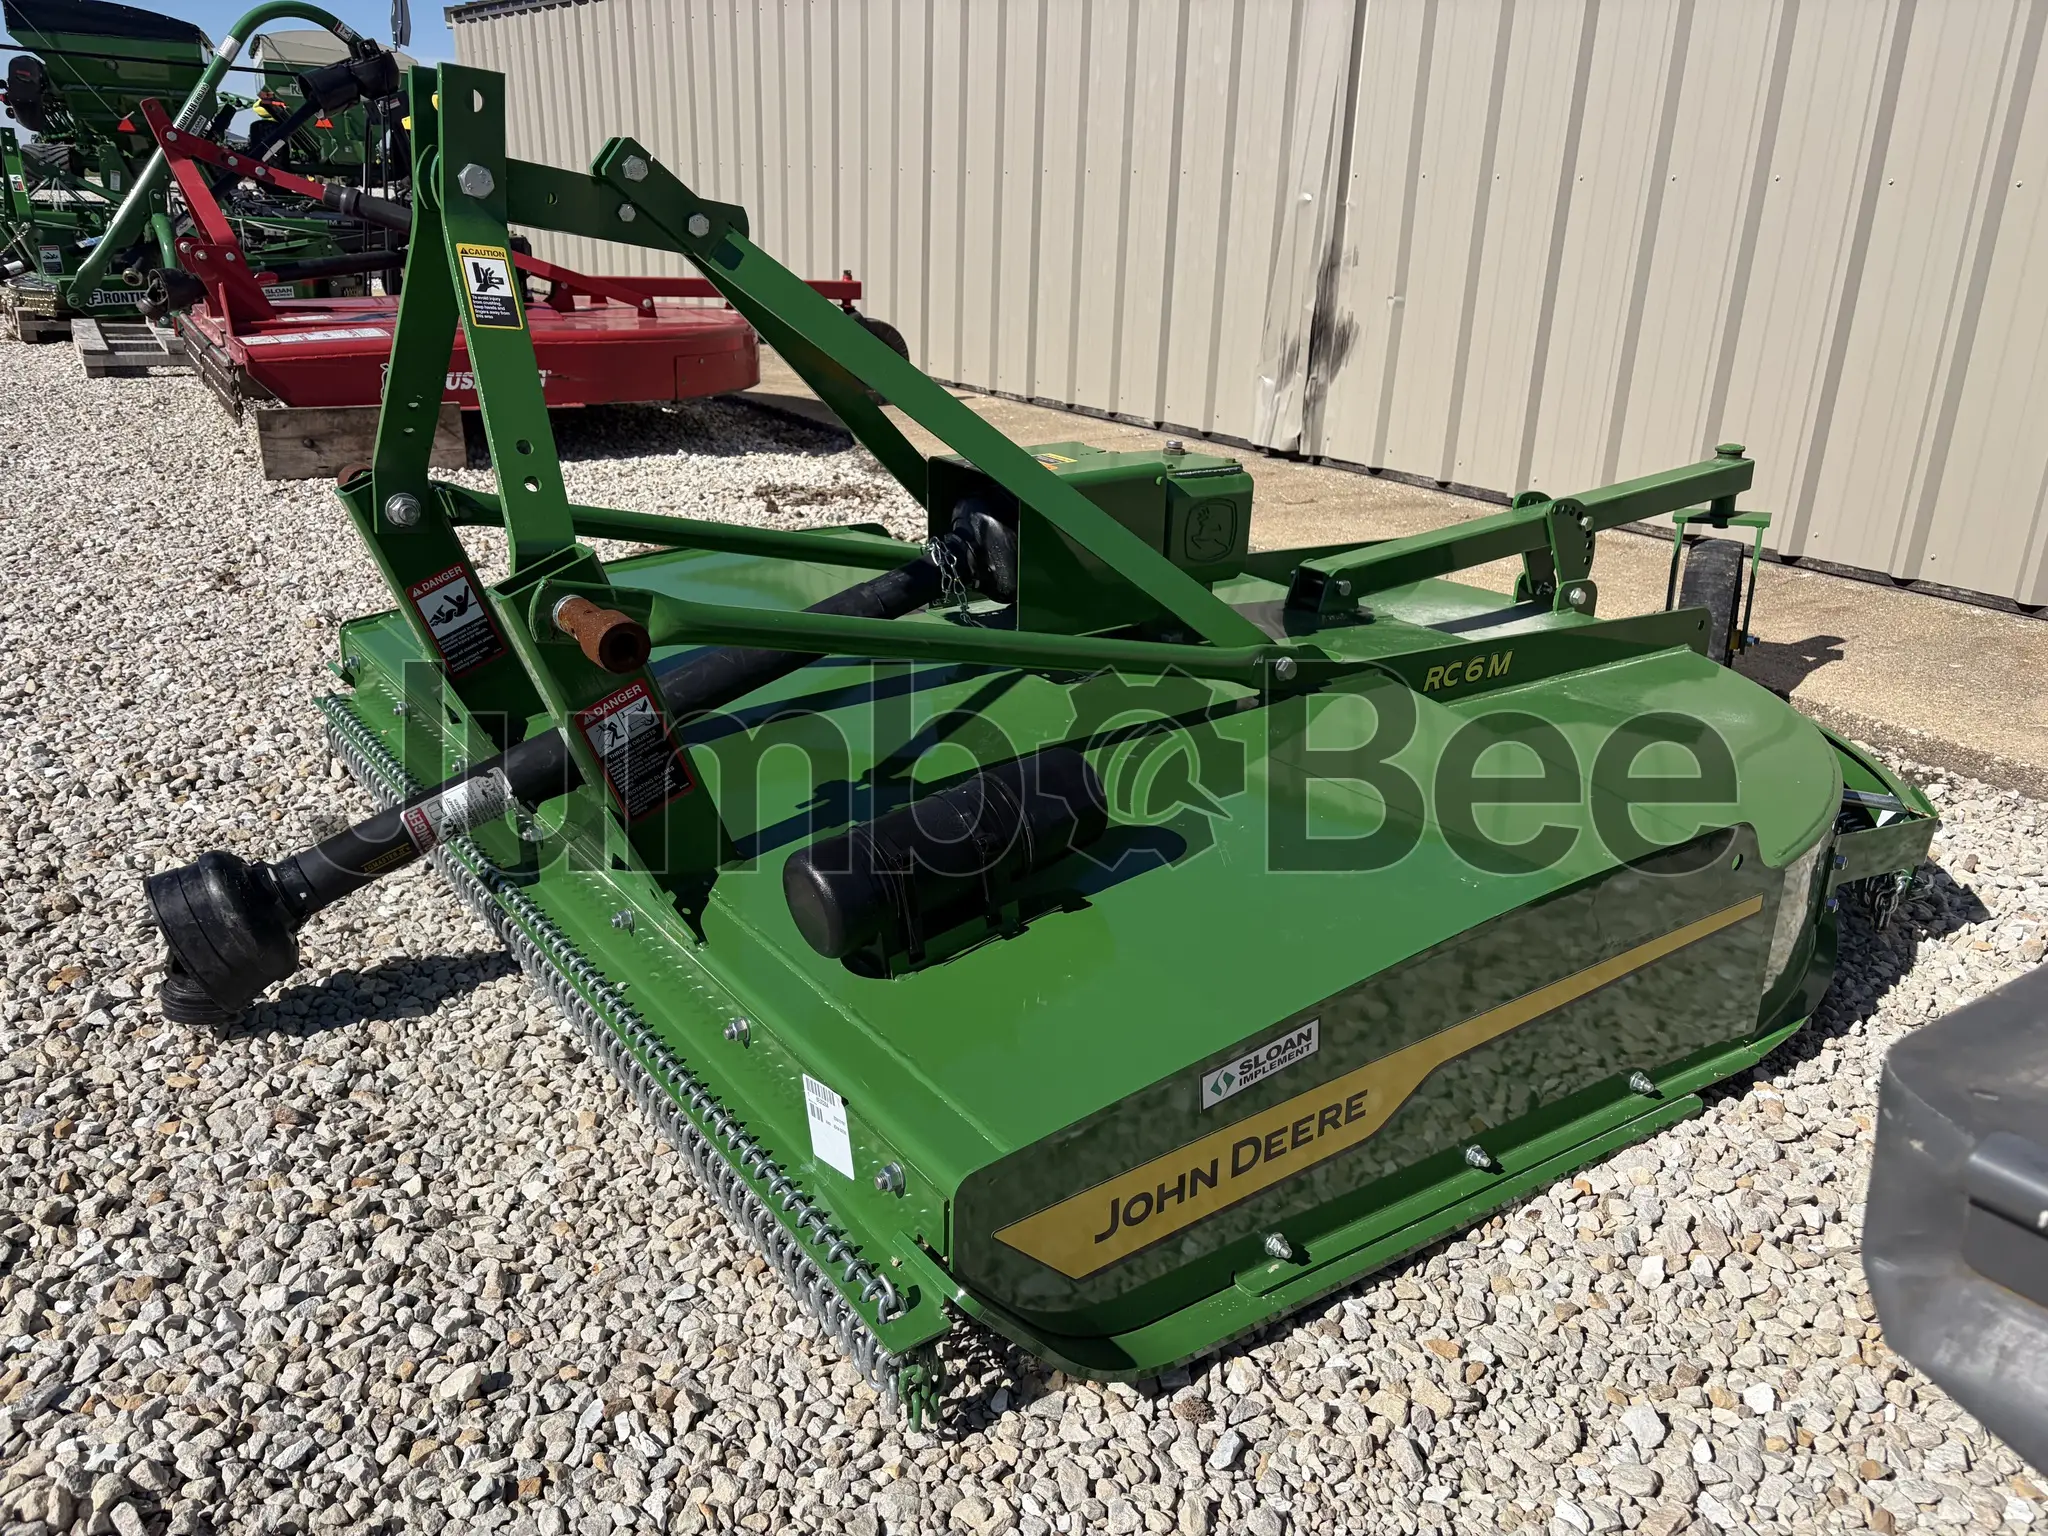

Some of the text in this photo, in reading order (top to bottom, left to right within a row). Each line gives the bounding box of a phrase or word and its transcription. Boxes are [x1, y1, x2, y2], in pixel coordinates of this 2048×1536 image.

[177, 102, 198, 130] RONTIER
[468, 248, 505, 258] CAUTION
[87, 288, 146, 306] FRONTI
[422, 566, 462, 591] DANGER
[594, 684, 642, 716] DANGER
[1238, 1028, 1312, 1076] SLOAN
[1239, 1042, 1312, 1086] IMPLEMENT
[1094, 1089, 1368, 1244] JOHN DEERE
